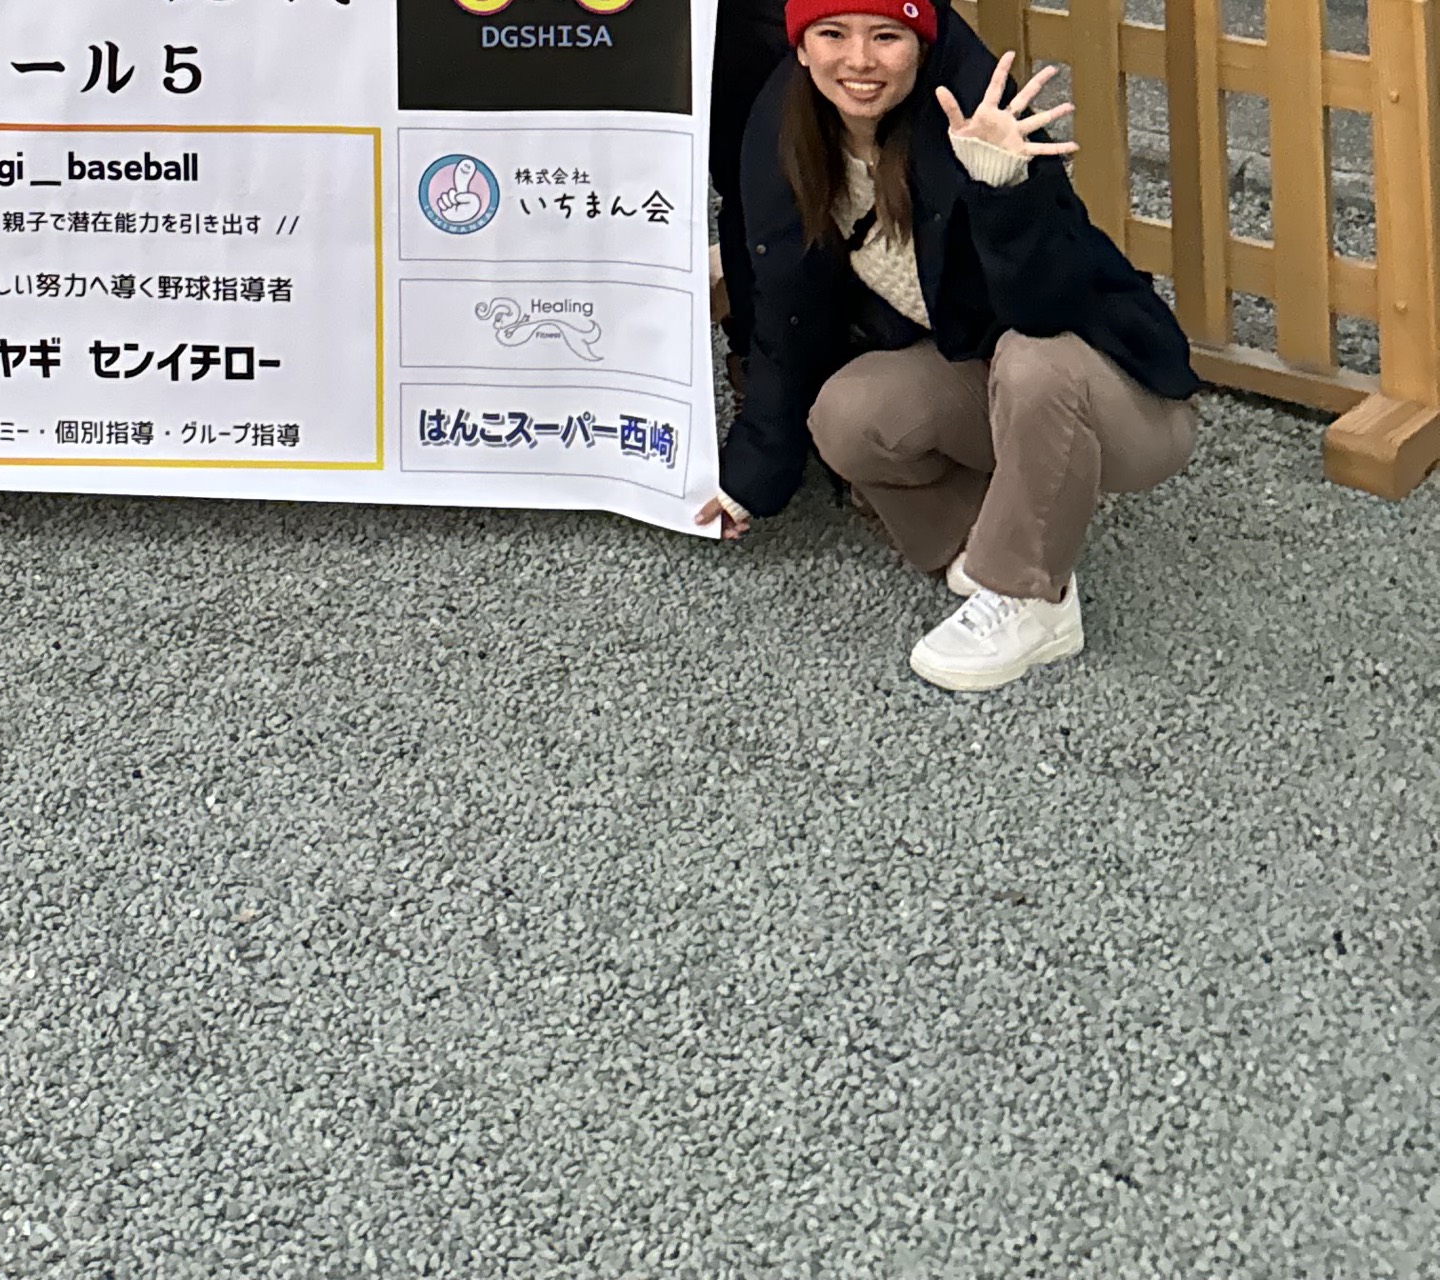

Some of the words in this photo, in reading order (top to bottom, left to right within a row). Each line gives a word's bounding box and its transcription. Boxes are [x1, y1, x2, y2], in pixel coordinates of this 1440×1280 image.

[481, 25, 613, 49] DGSHISA
[514, 167, 591, 185] 株式会社
[519, 189, 675, 225] いちまん会
[530, 299, 594, 317] Healing
[88, 339, 281, 381] センイチロー
